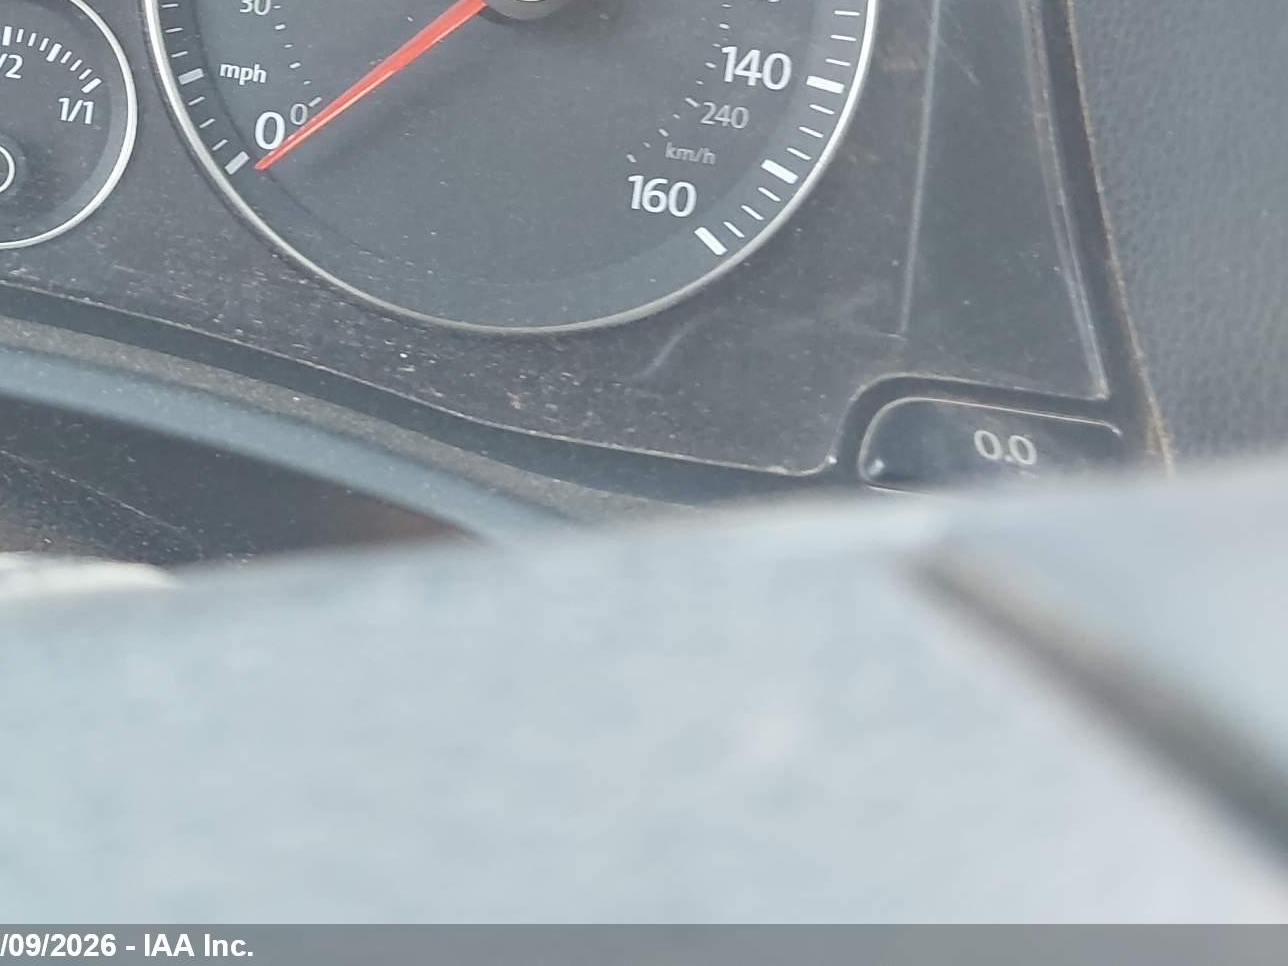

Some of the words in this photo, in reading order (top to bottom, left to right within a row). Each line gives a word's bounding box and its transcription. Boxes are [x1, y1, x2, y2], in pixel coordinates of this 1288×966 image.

[219, 61, 267, 87] mph
[721, 46, 792, 90] 140
[58, 96, 94, 125] 1/1
[289, 103, 309, 126] 0
[700, 103, 749, 129] 240
[254, 111, 286, 151] 0
[665, 142, 716, 166] km/h
[628, 174, 697, 218] 160
[974, 430, 1037, 465] 0.0
